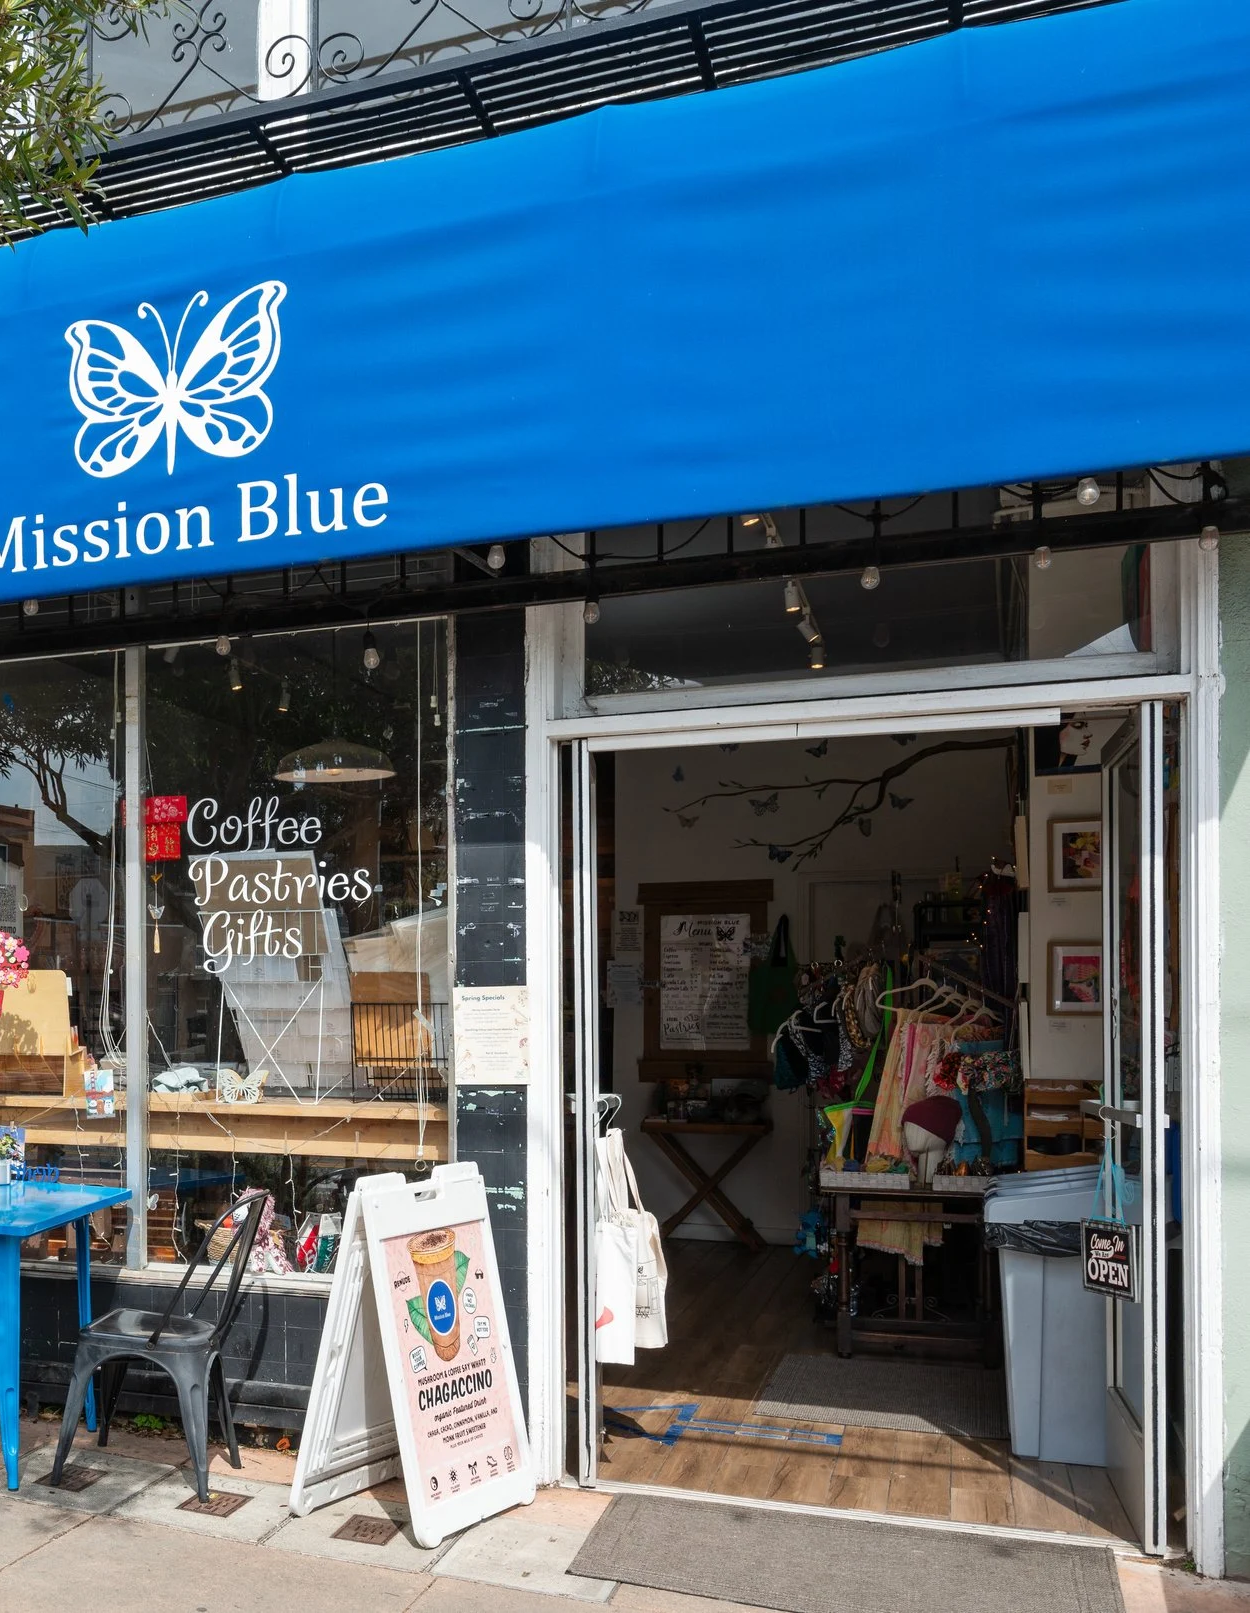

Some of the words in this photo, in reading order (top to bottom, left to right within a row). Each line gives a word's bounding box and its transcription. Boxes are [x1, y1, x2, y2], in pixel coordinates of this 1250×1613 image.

[237, 473, 389, 543] Blue
[186, 796, 322, 853] Coffee
[188, 851, 372, 907] Pastries
[202, 909, 303, 974] Gifts
[673, 920, 712, 937] Menu
[1090, 1233, 1112, 1250] Come
[1112, 1235, 1125, 1252] In
[1087, 1258, 1129, 1288] OPEN
[418, 1372, 445, 1386] MUSHROOM
[448, 1366, 462, 1376] COFFEE
[462, 1363, 471, 1373] SAY
[471, 1358, 486, 1369] WHAT?
[418, 1368, 492, 1411] CHAGACCINO
[452, 1401, 473, 1414] Featured
